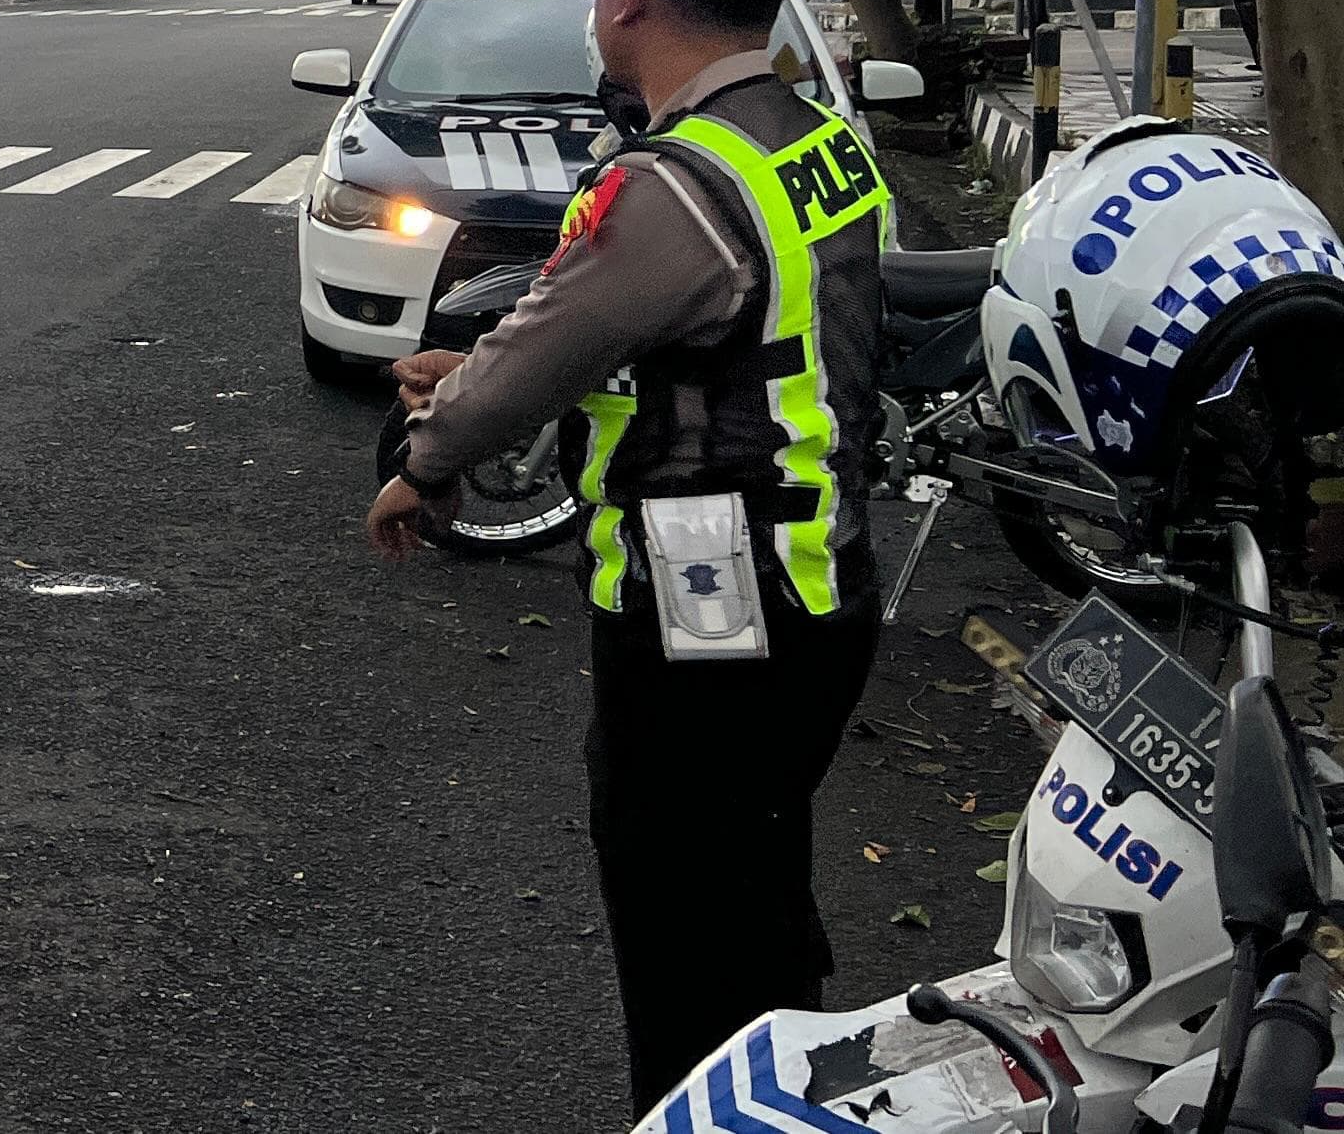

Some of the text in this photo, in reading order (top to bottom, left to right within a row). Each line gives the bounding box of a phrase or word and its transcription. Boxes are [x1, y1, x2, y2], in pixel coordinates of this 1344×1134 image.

[439, 115, 606, 132] POL
[1091, 148, 1295, 238] POLIS
[1037, 762, 1184, 902] POLISI
